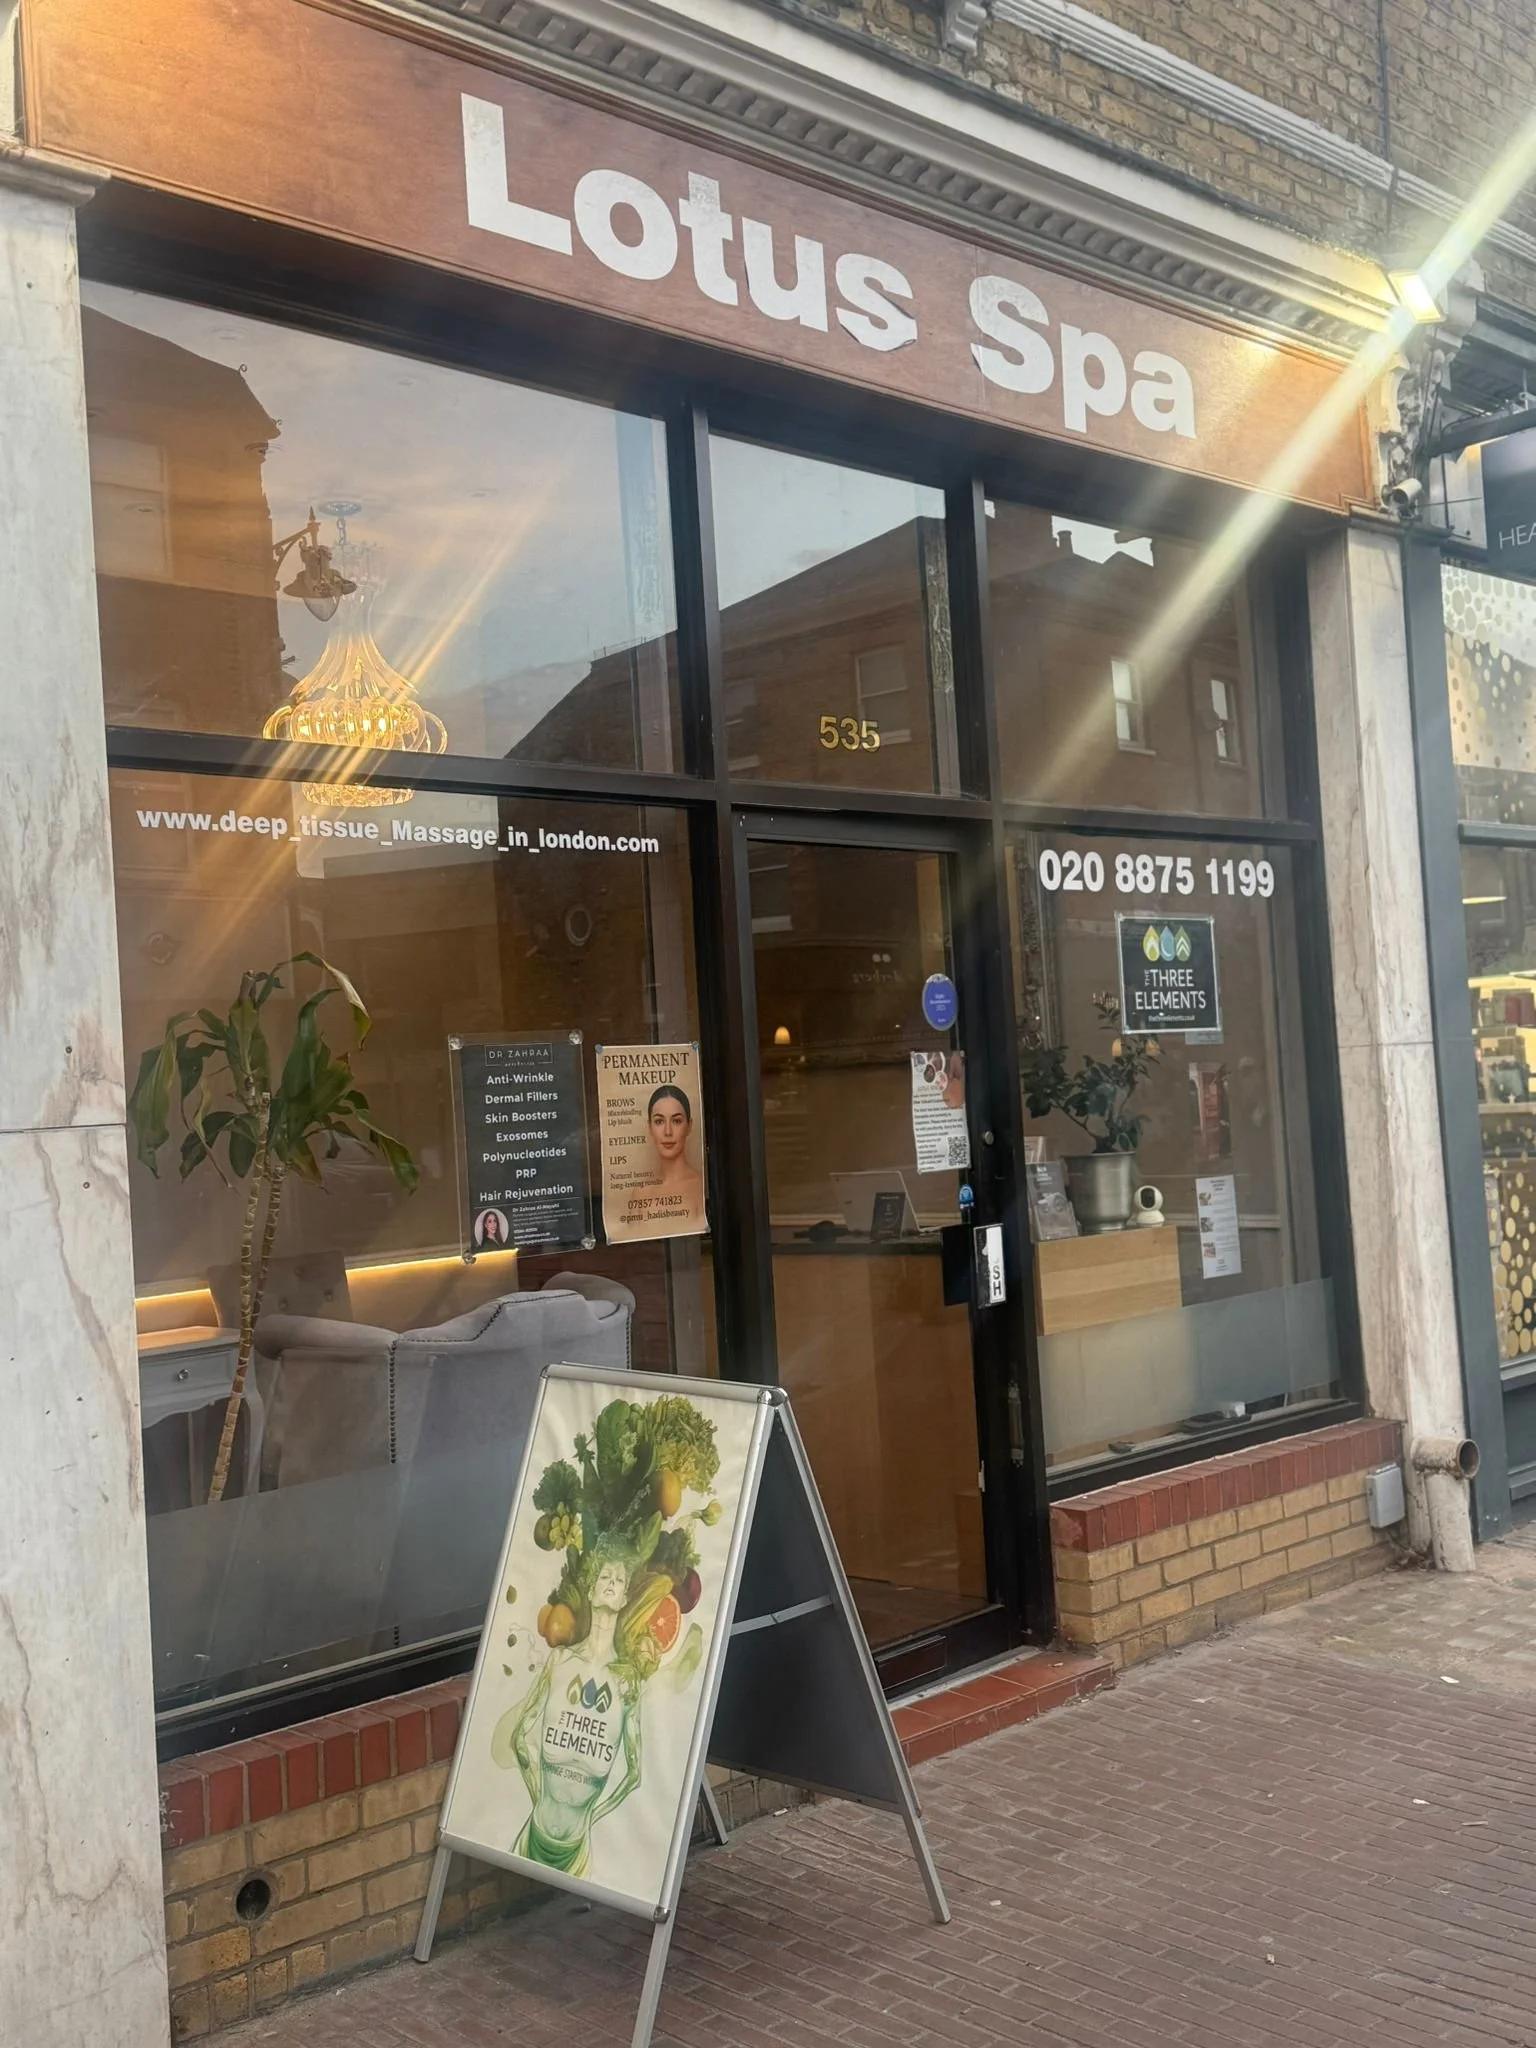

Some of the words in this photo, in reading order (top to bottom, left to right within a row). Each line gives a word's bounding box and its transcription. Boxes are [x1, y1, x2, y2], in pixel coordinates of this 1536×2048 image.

[461, 92, 917, 352] Lotus
[969, 274, 1197, 439] Spa
[820, 715, 881, 752] 535
[136, 809, 660, 853] www.deep_tissue_Massage_in_london.com
[1039, 849, 1105, 892] 020
[1115, 853, 1195, 895] 8875
[1205, 858, 1275, 897] 1199
[1150, 968, 1195, 987] THREE
[1135, 990, 1207, 1010] ELEMENTS
[489, 1050, 503, 1059] DR
[508, 1049, 549, 1058] ZAHRAA
[603, 1052, 690, 1069] PERMANENT
[486, 1072, 554, 1085] Anti-Wrinkle
[618, 1070, 676, 1086] MAKEUP
[485, 1093, 524, 1104] Dermal
[526, 1091, 558, 1102] Fillers
[606, 1098, 636, 1108] BROWS
[485, 1112, 509, 1124] Skin
[512, 1110, 557, 1122] Boosters
[496, 1130, 548, 1142] Exosomes
[608, 1136, 647, 1146] EYELINER
[482, 1147, 567, 1163] Polynucleotides
[609, 1155, 628, 1165] LIPS
[515, 1168, 537, 1179] PRP
[479, 1190, 501, 1202] Hair
[504, 1184, 573, 1200] Rejuvenation
[627, 1198, 653, 1210] 07857
[655, 1195, 682, 1208] 741823
[565, 1711, 608, 1739] THREE
[545, 1727, 613, 1762] ELEMENTS
